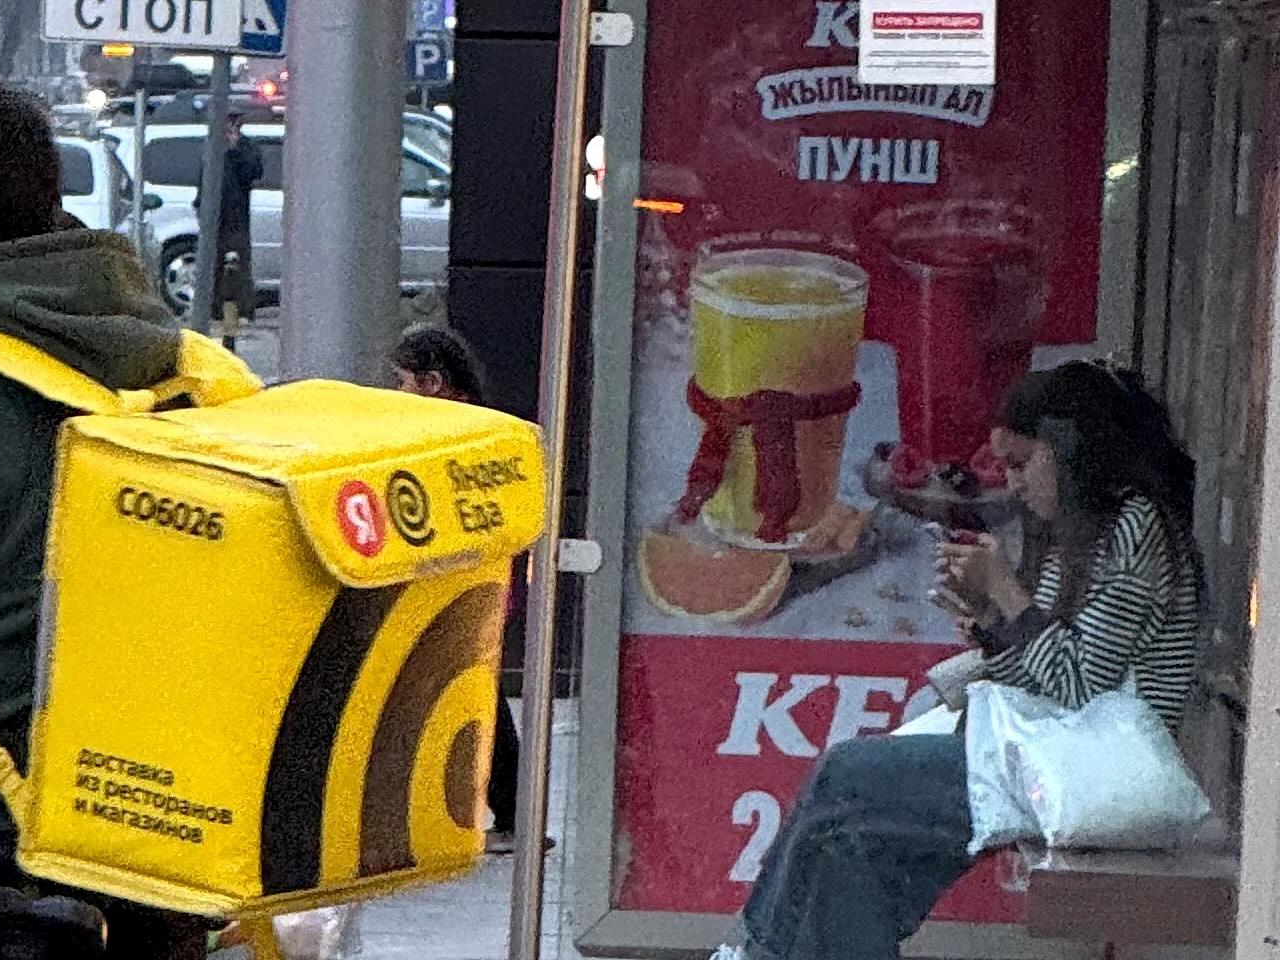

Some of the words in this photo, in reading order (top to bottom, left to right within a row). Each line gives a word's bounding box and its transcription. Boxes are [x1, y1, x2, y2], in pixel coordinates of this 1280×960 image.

[797, 135, 940, 184] ПУНШ
[455, 497, 505, 533] Еда
[74, 798, 88, 812] и
[93, 802, 203, 844] магазинов
[76, 773, 101, 792] из
[104, 780, 234, 826] ресторанов
